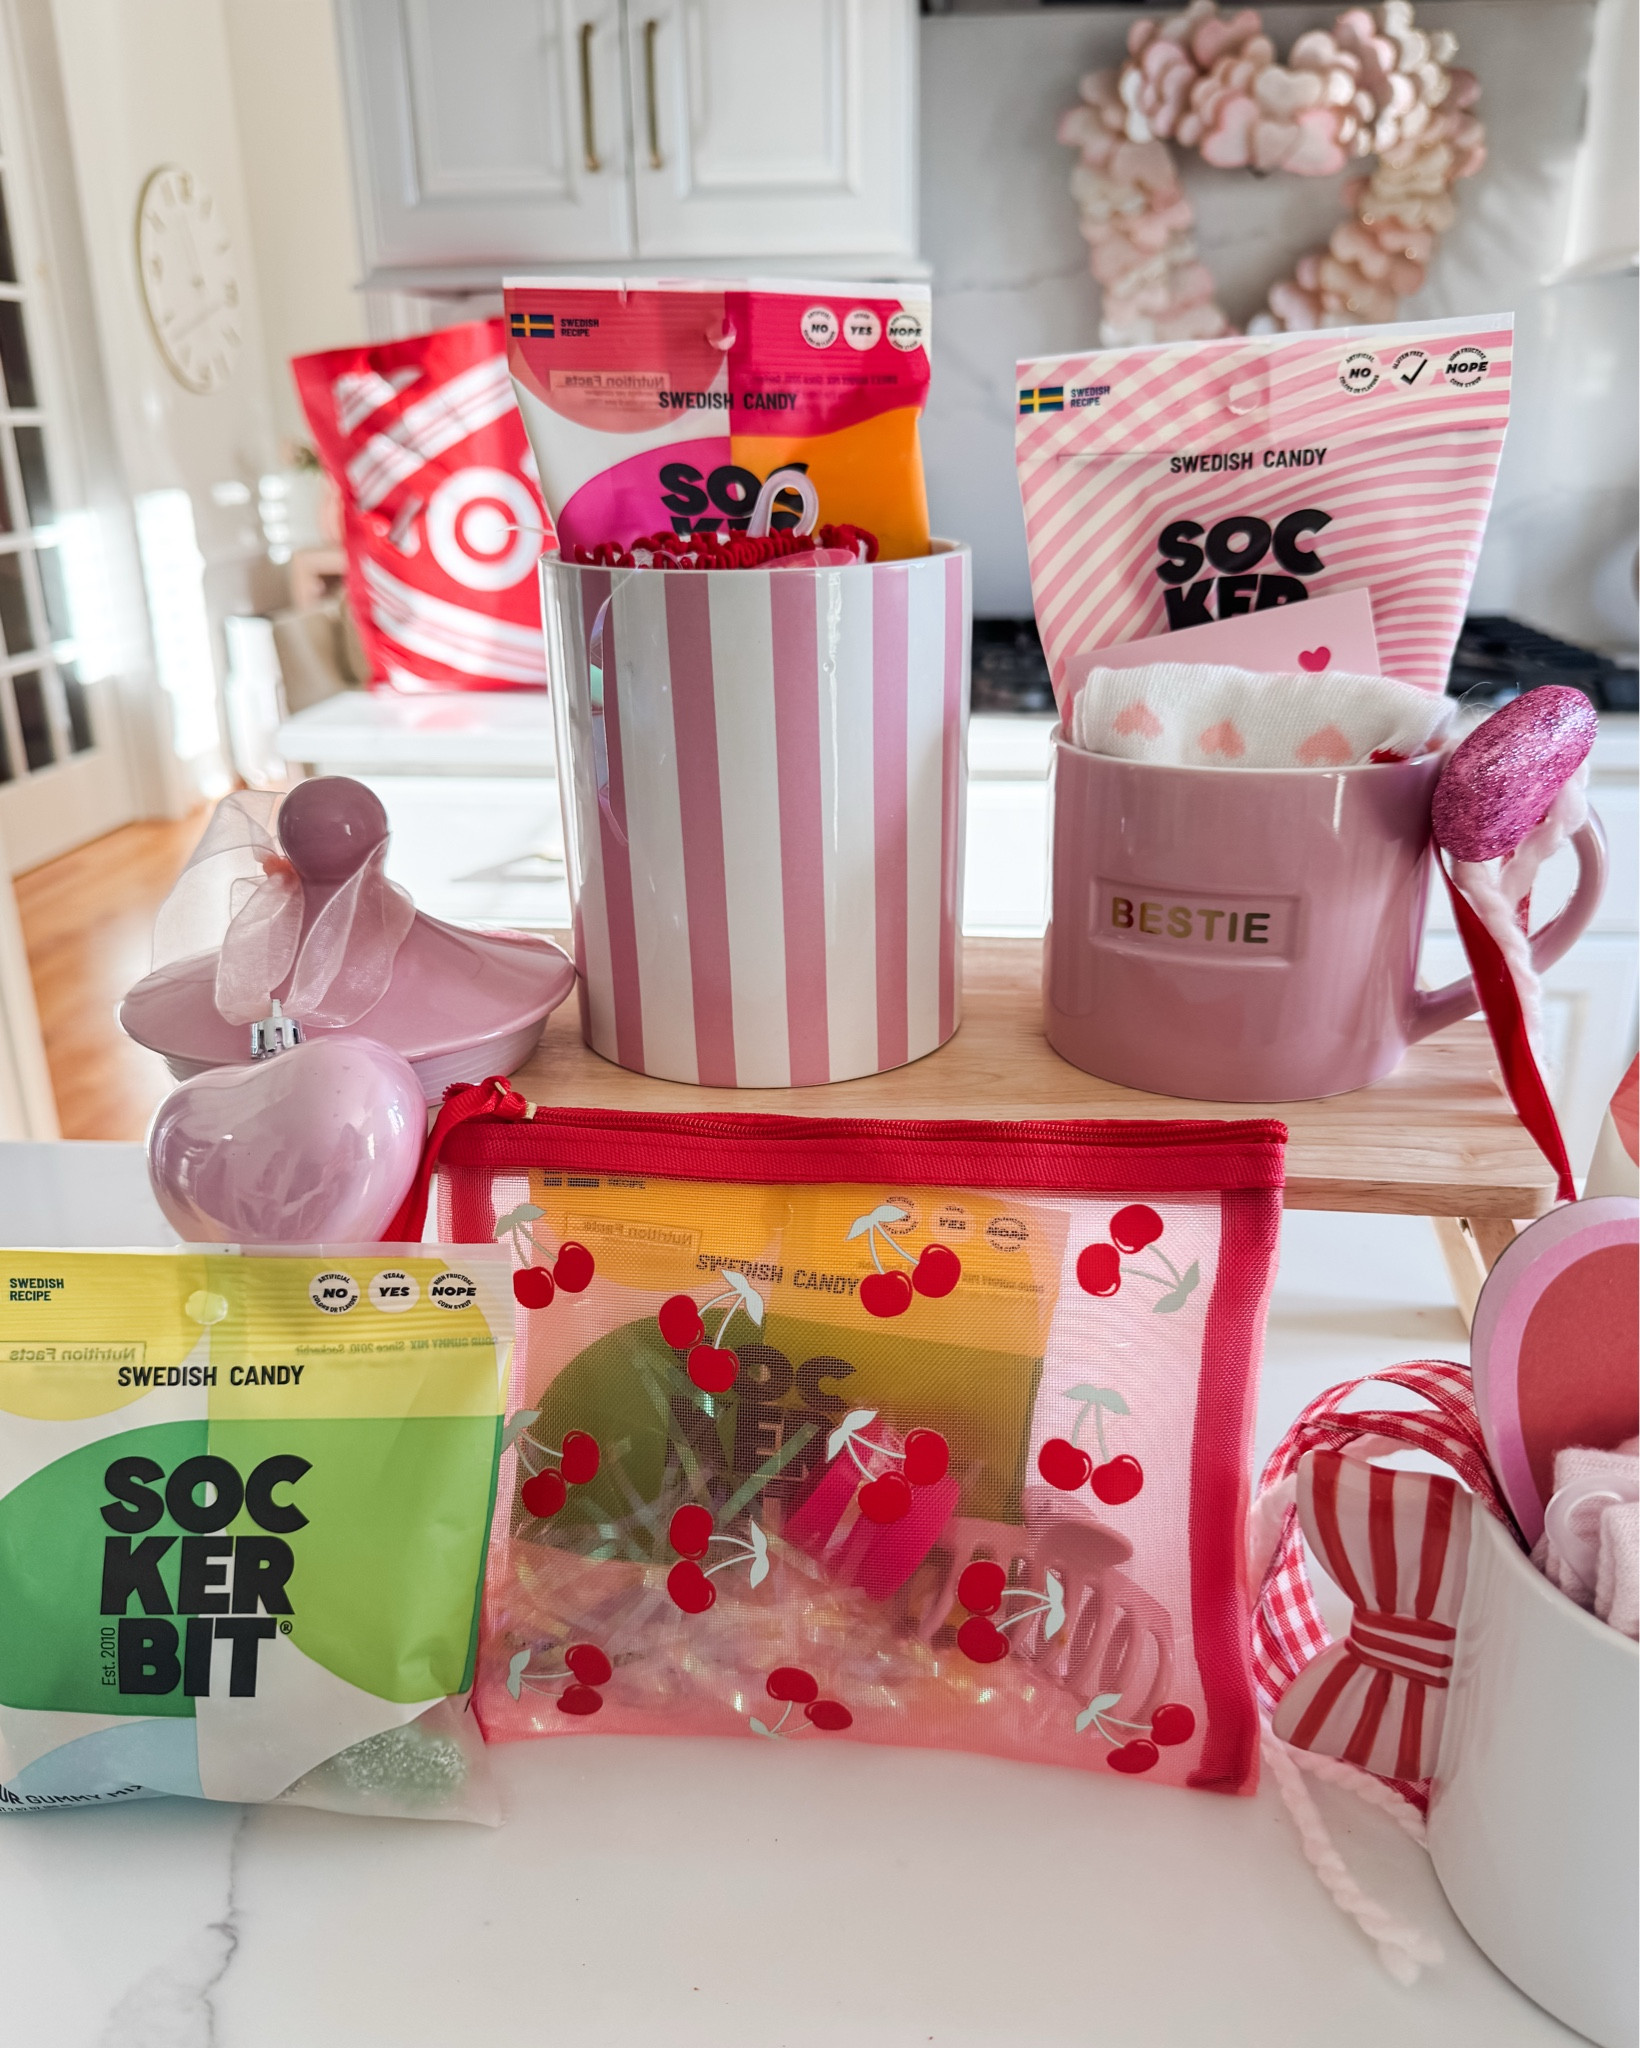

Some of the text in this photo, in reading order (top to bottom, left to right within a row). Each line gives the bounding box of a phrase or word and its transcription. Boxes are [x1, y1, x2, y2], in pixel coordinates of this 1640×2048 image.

[560, 318, 599, 328] SWEDISH
[811, 323, 829, 334] NO
[561, 328, 590, 337] RECIPE
[850, 325, 873, 336] YES
[889, 327, 923, 337] NOPE
[1349, 367, 1372, 379] NO
[1445, 361, 1489, 374] NOPE
[1070, 385, 1110, 398] SWEDISH
[659, 391, 734, 410] SWEDISH
[743, 392, 798, 411] CANDY
[1070, 396, 1101, 408] RECIPE
[1170, 447, 1328, 474] SWEDISH CANDY
[1156, 509, 1333, 585] SOC
[1112, 896, 1271, 944] BESTIE
[318, 1273, 350, 1284] ARTIFICIAL
[383, 1272, 406, 1280] VEGAN
[445, 1273, 475, 1286] FRUCTOSE
[9, 1278, 65, 1289] SWEDISH
[793, 1269, 860, 1298] CANDY
[9, 1290, 52, 1301] RECIPE
[323, 1288, 348, 1299] NO
[379, 1286, 410, 1297] YES
[431, 1286, 477, 1297] NOPE
[437, 1299, 453, 1310] CORN
[117, 1364, 305, 1387] SWEDISH CANDY
[100, 1454, 314, 1534] SOC
[100, 1536, 296, 1615] KER
[100, 1626, 117, 1686] Est. 2010
[0, 1783, 25, 1805] UR
[25, 1793, 102, 1805] GUMMY
